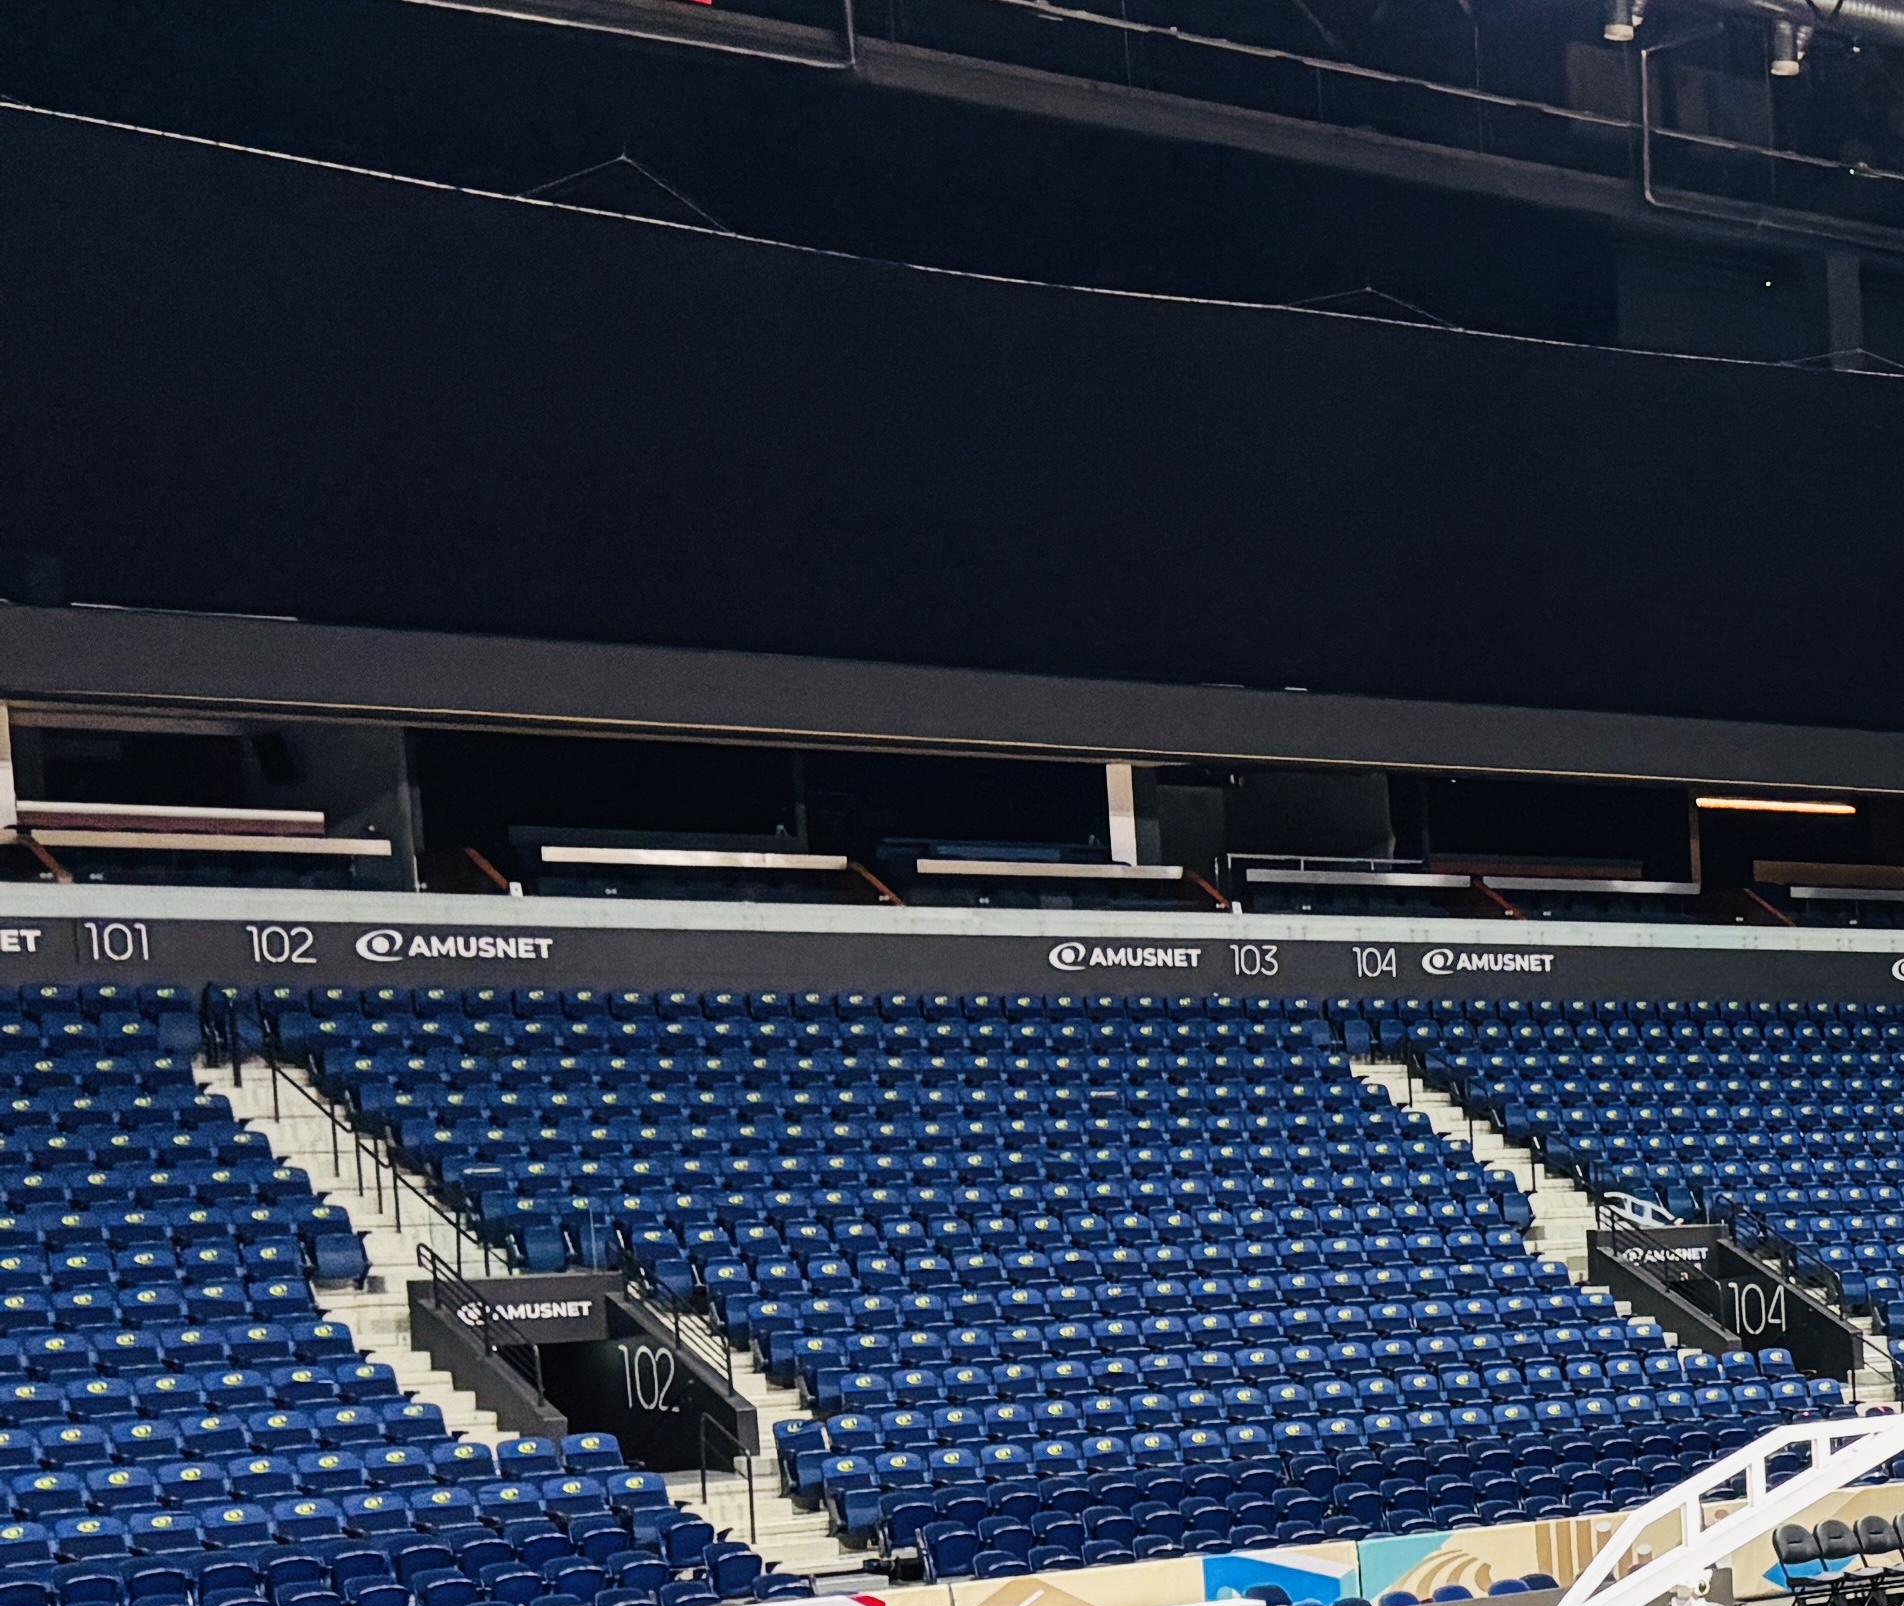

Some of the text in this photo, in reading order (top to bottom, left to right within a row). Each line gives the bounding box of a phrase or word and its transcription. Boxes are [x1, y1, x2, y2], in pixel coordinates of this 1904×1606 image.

[85, 923, 149, 960] 101
[246, 926, 317, 963] 102
[409, 936, 553, 959] AMUSNET
[1089, 948, 1201, 967] AMUSNET
[1230, 945, 1278, 975] 103
[1353, 947, 1396, 977] 104
[1456, 953, 1554, 971] AMUSNET
[1729, 1282, 1786, 1335] 104
[618, 1345, 680, 1412] 102
